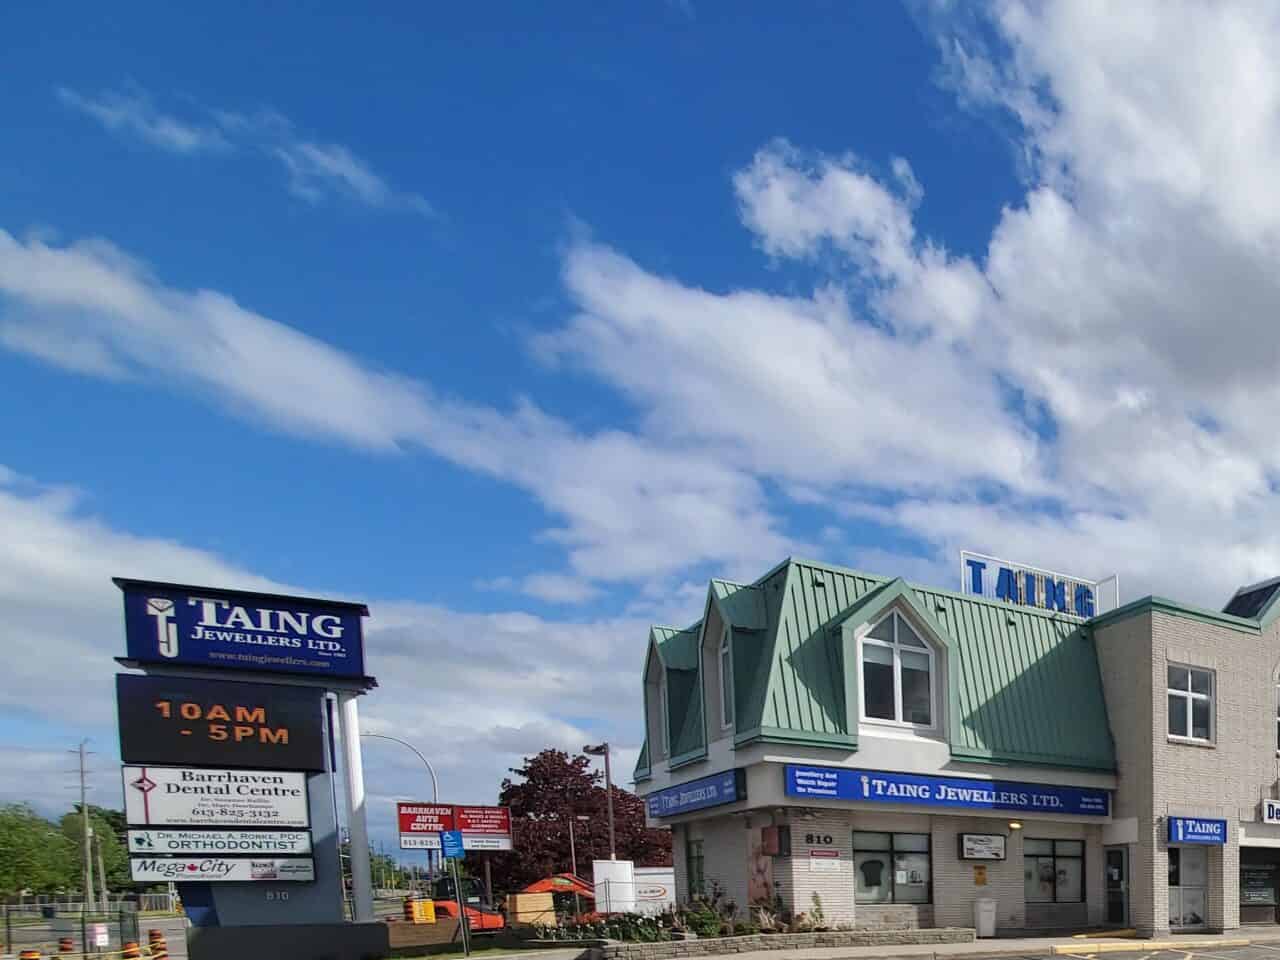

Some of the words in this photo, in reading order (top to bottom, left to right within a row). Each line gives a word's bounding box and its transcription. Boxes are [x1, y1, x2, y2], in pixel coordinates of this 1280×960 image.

[967, 559, 1095, 618] TAING
[188, 597, 345, 638] TAING
[191, 626, 301, 648] JEWELLERS
[308, 640, 347, 652] LTD.
[207, 724, 288, 745] 5PM
[181, 771, 284, 784] Barrhaven
[166, 783, 231, 795] Dental
[236, 785, 301, 797] Centre
[872, 779, 931, 799] TAING
[936, 784, 1031, 806] JEWELLERS
[1033, 794, 1064, 808] LTD.
[192, 808, 280, 818] 613-825-3132
[1186, 820, 1221, 834] TAING
[168, 840, 296, 850] ORTHODONTIST
[805, 834, 833, 845] 810
[137, 859, 185, 877] Mega
[199, 859, 236, 876] City
